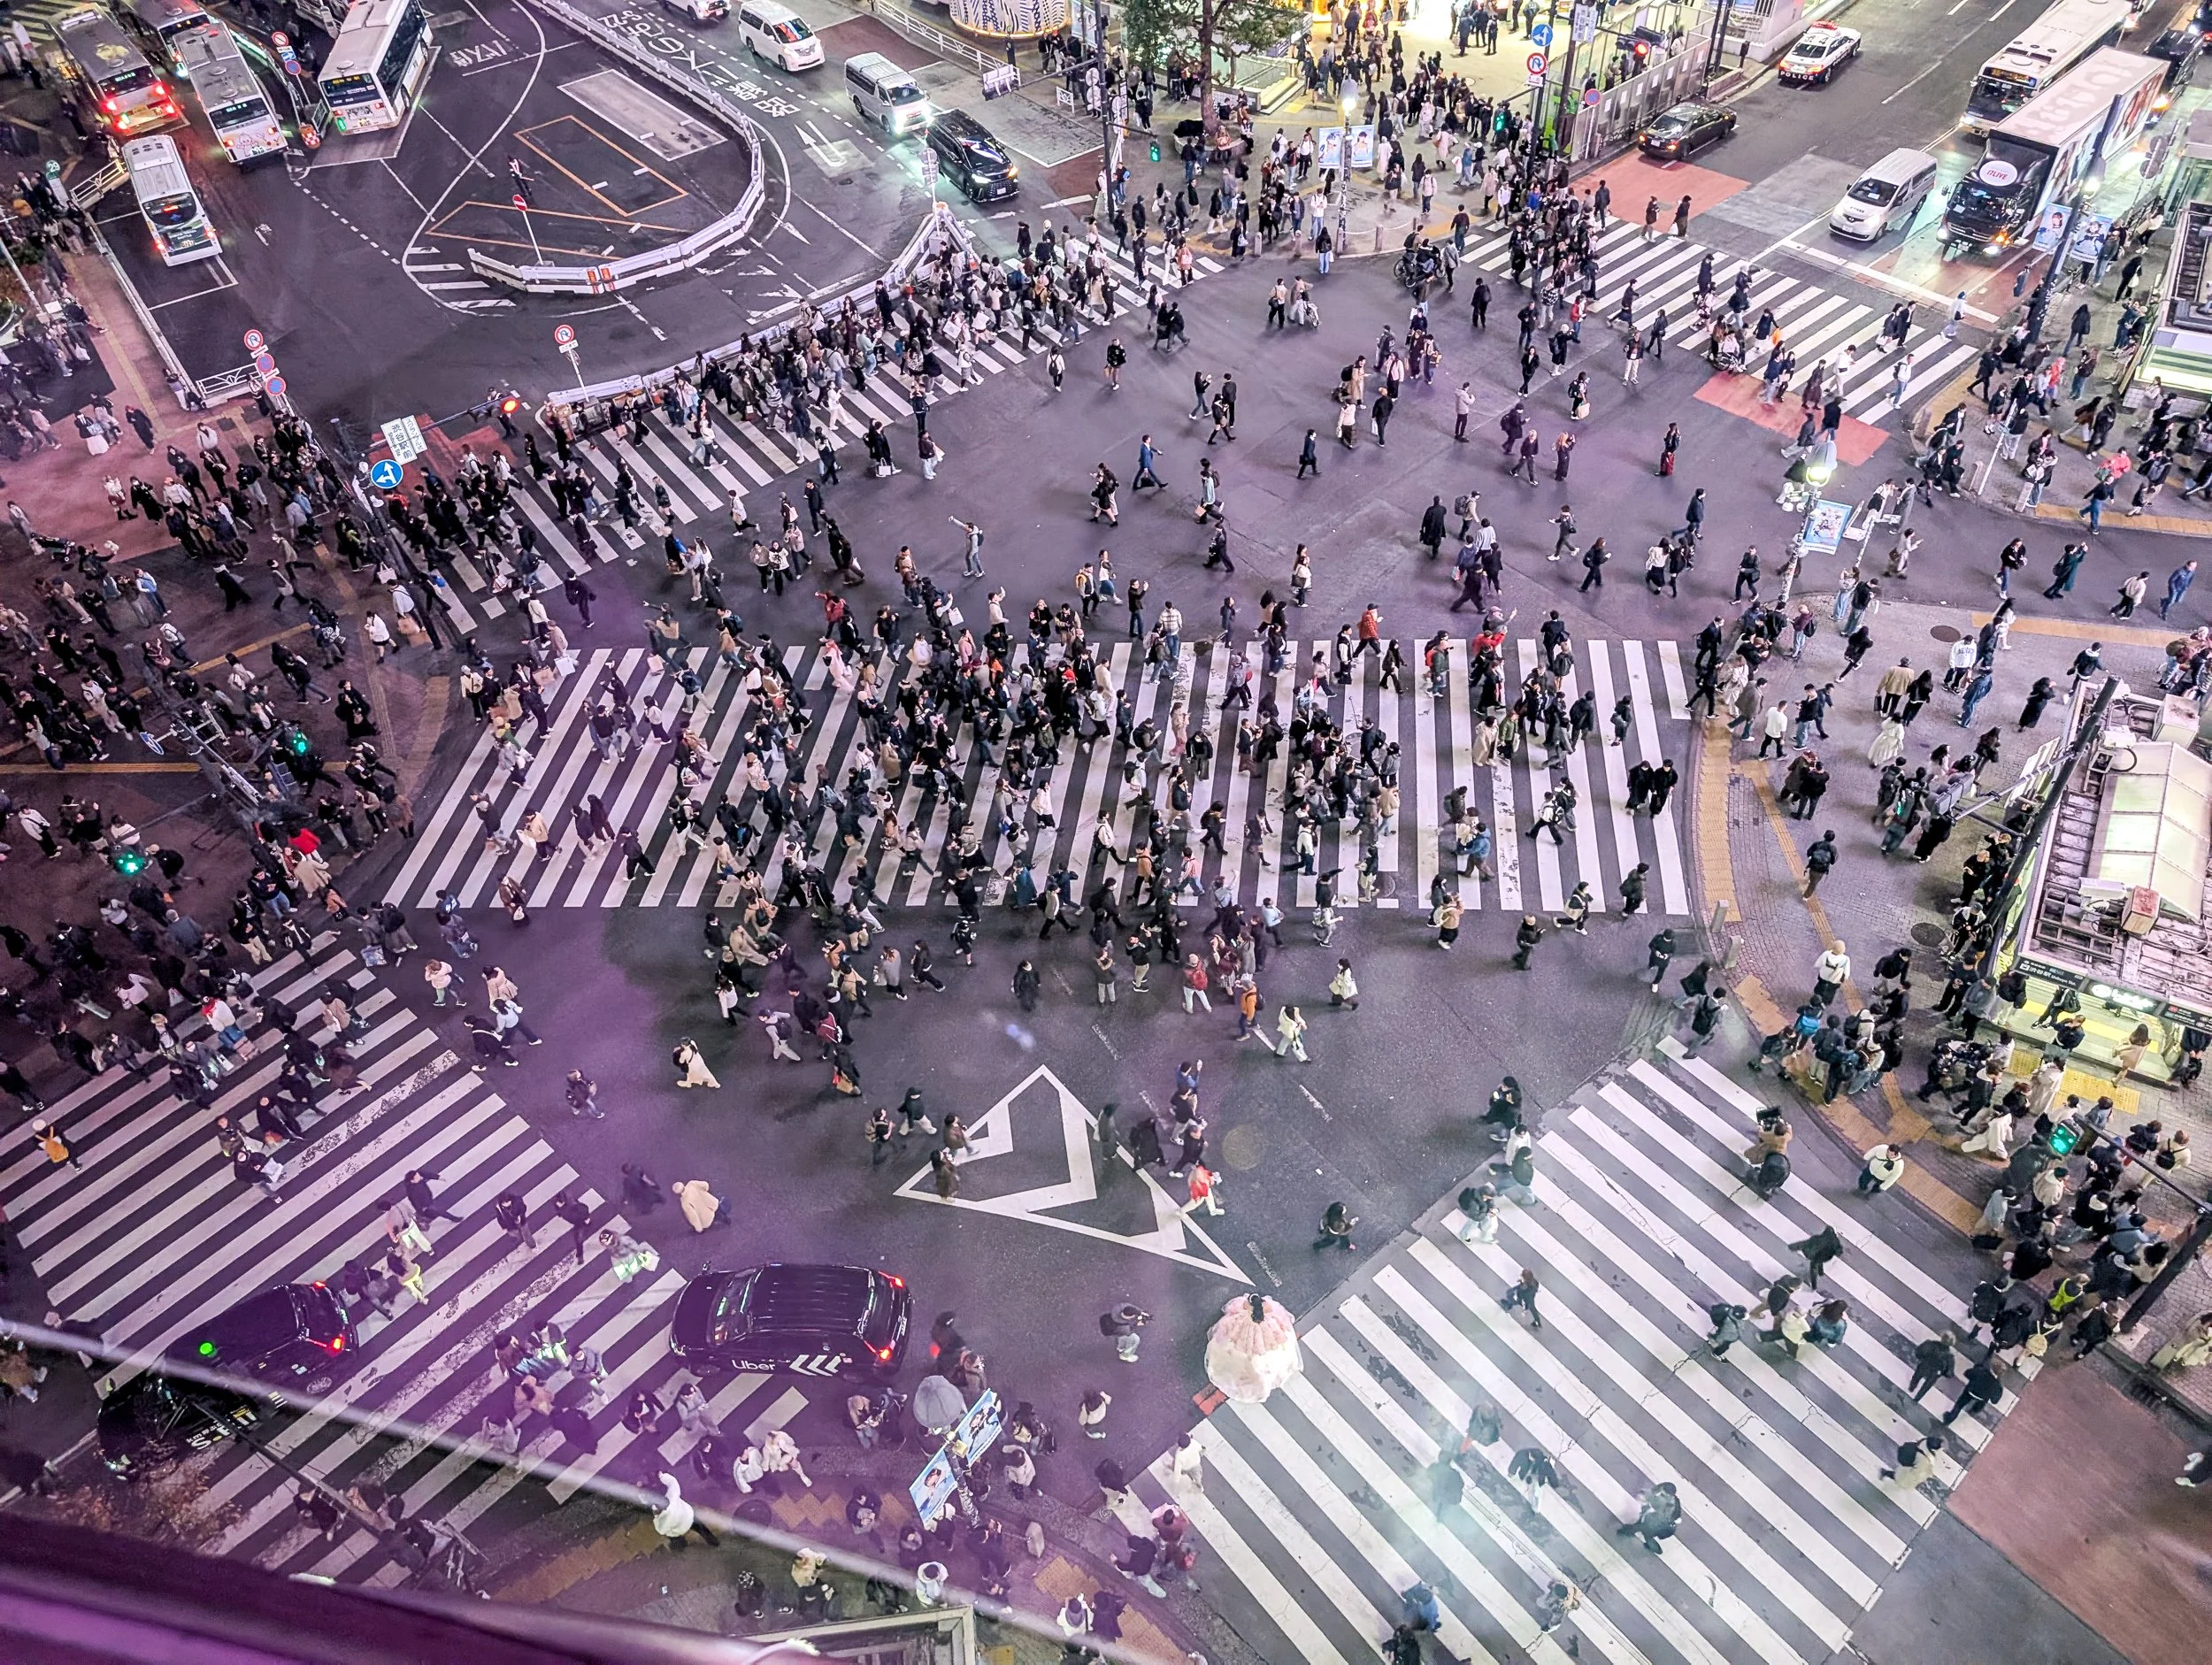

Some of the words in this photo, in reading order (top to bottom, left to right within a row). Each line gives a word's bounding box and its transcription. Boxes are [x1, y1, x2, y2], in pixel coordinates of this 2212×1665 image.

[1780, 71, 1814, 81] POLICE
[48, 162, 60, 173] 29
[391, 424, 412, 459] 渋谷駅前
[731, 1359, 775, 1370] Uber
